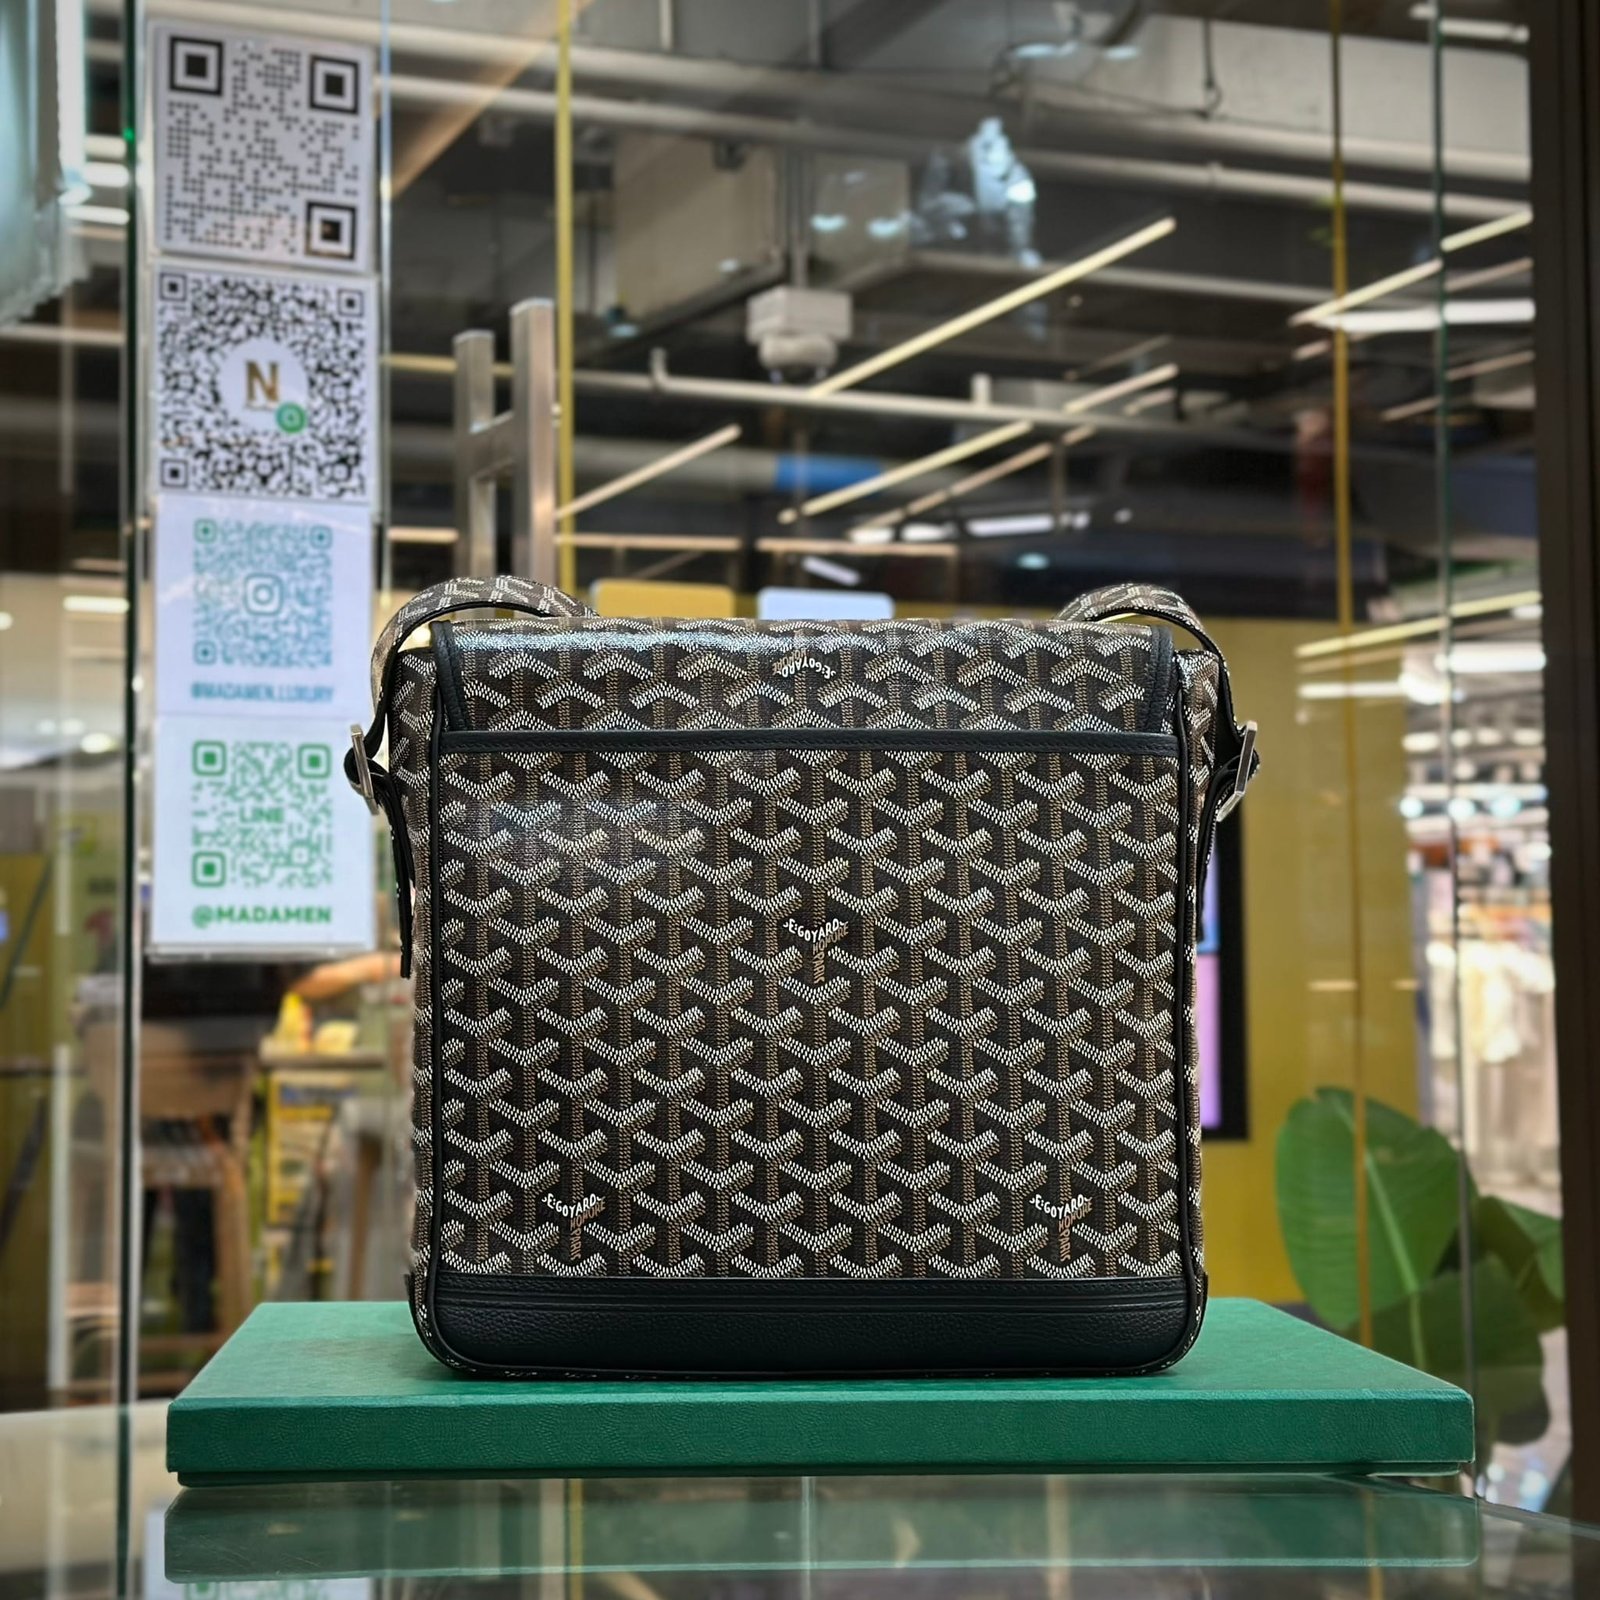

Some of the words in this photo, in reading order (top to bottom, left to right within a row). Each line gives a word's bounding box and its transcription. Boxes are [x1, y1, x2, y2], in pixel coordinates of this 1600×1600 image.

[239, 807, 283, 823] LINE
[192, 906, 331, 927] @MADAMEN
[1059, 1228, 1071, 1261] PARIS
